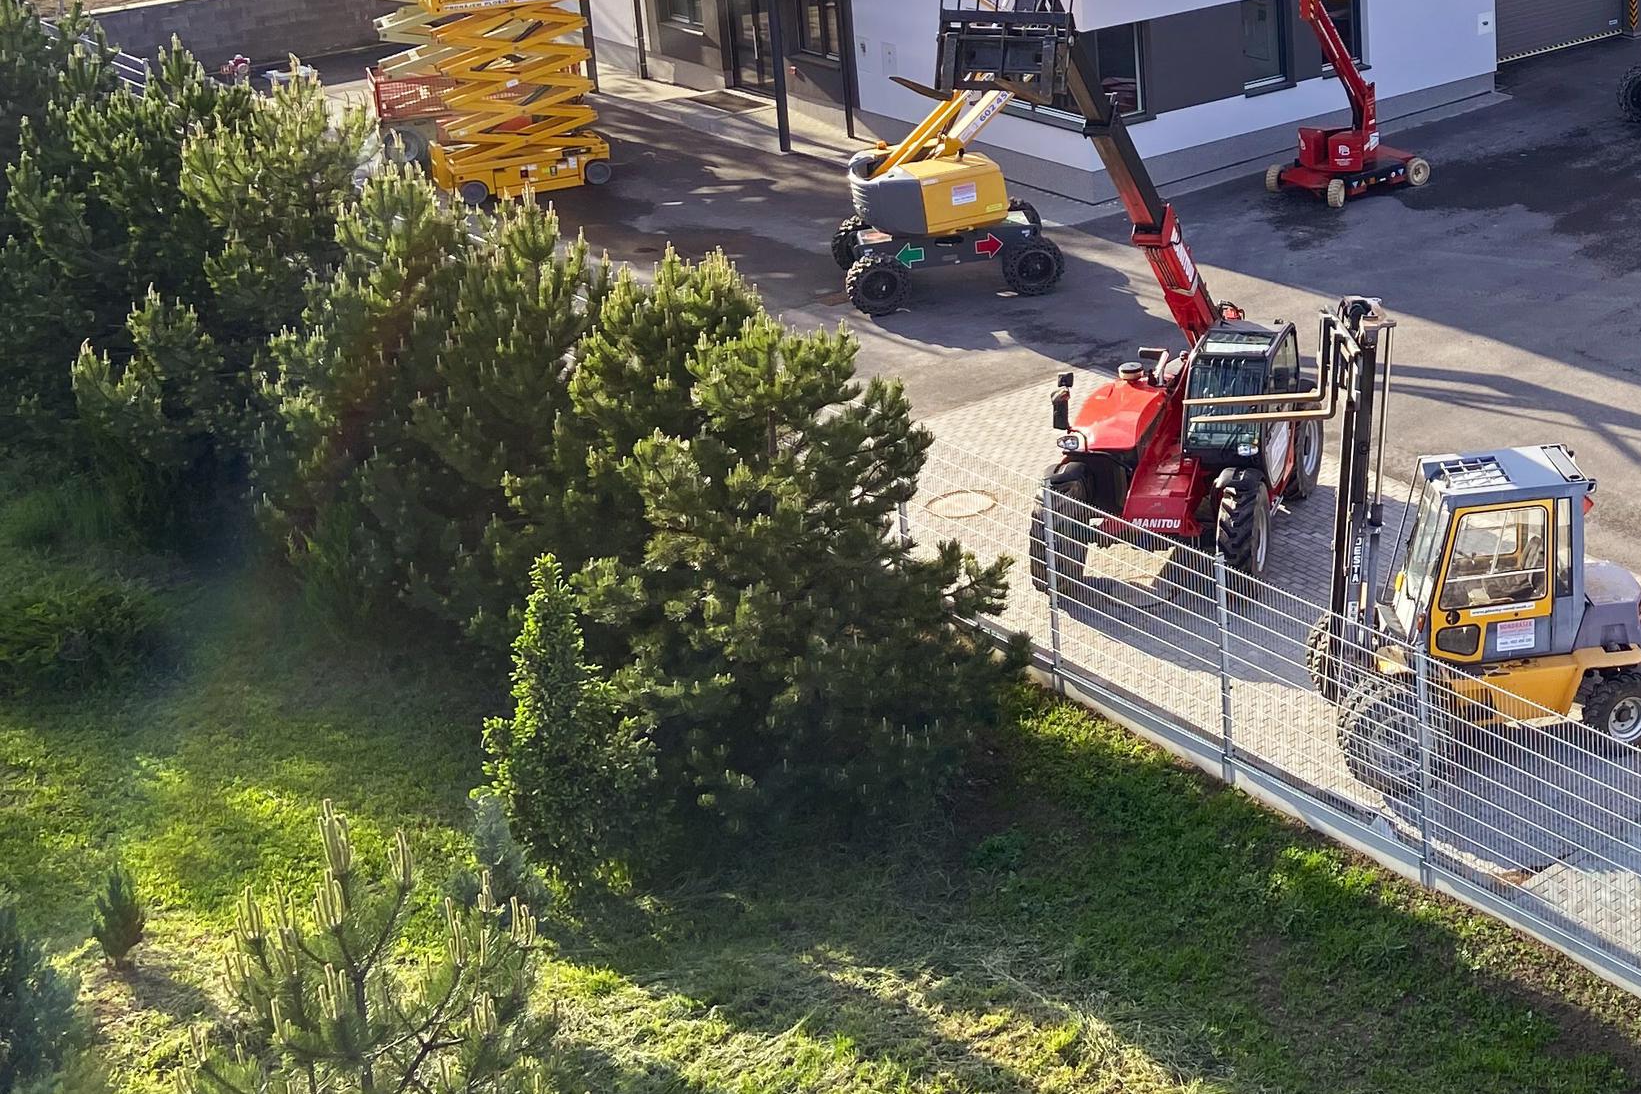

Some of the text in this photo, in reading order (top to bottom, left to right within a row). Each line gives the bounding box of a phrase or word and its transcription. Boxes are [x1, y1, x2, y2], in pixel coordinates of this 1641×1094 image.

[979, 105, 996, 123] 602
[1131, 518, 1181, 529] MANITOU
[1351, 537, 1362, 583] DESTA
